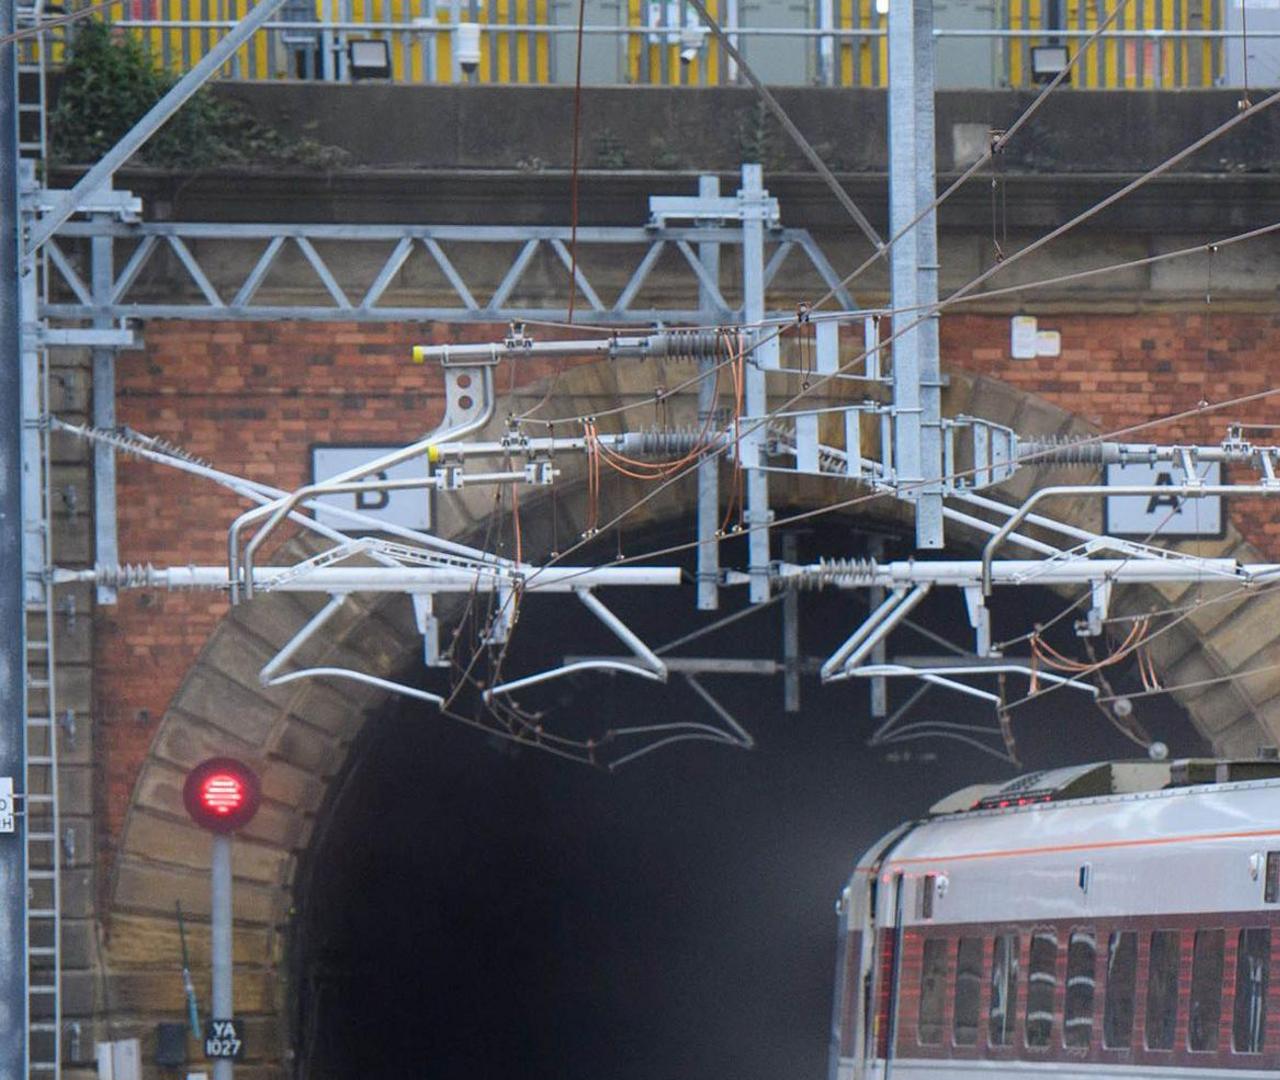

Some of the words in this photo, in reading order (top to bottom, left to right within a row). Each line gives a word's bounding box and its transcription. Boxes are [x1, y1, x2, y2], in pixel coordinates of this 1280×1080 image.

[1146, 472, 1183, 514] A
[212, 1022, 237, 1038] YA
[206, 1039, 242, 1056] 1027
